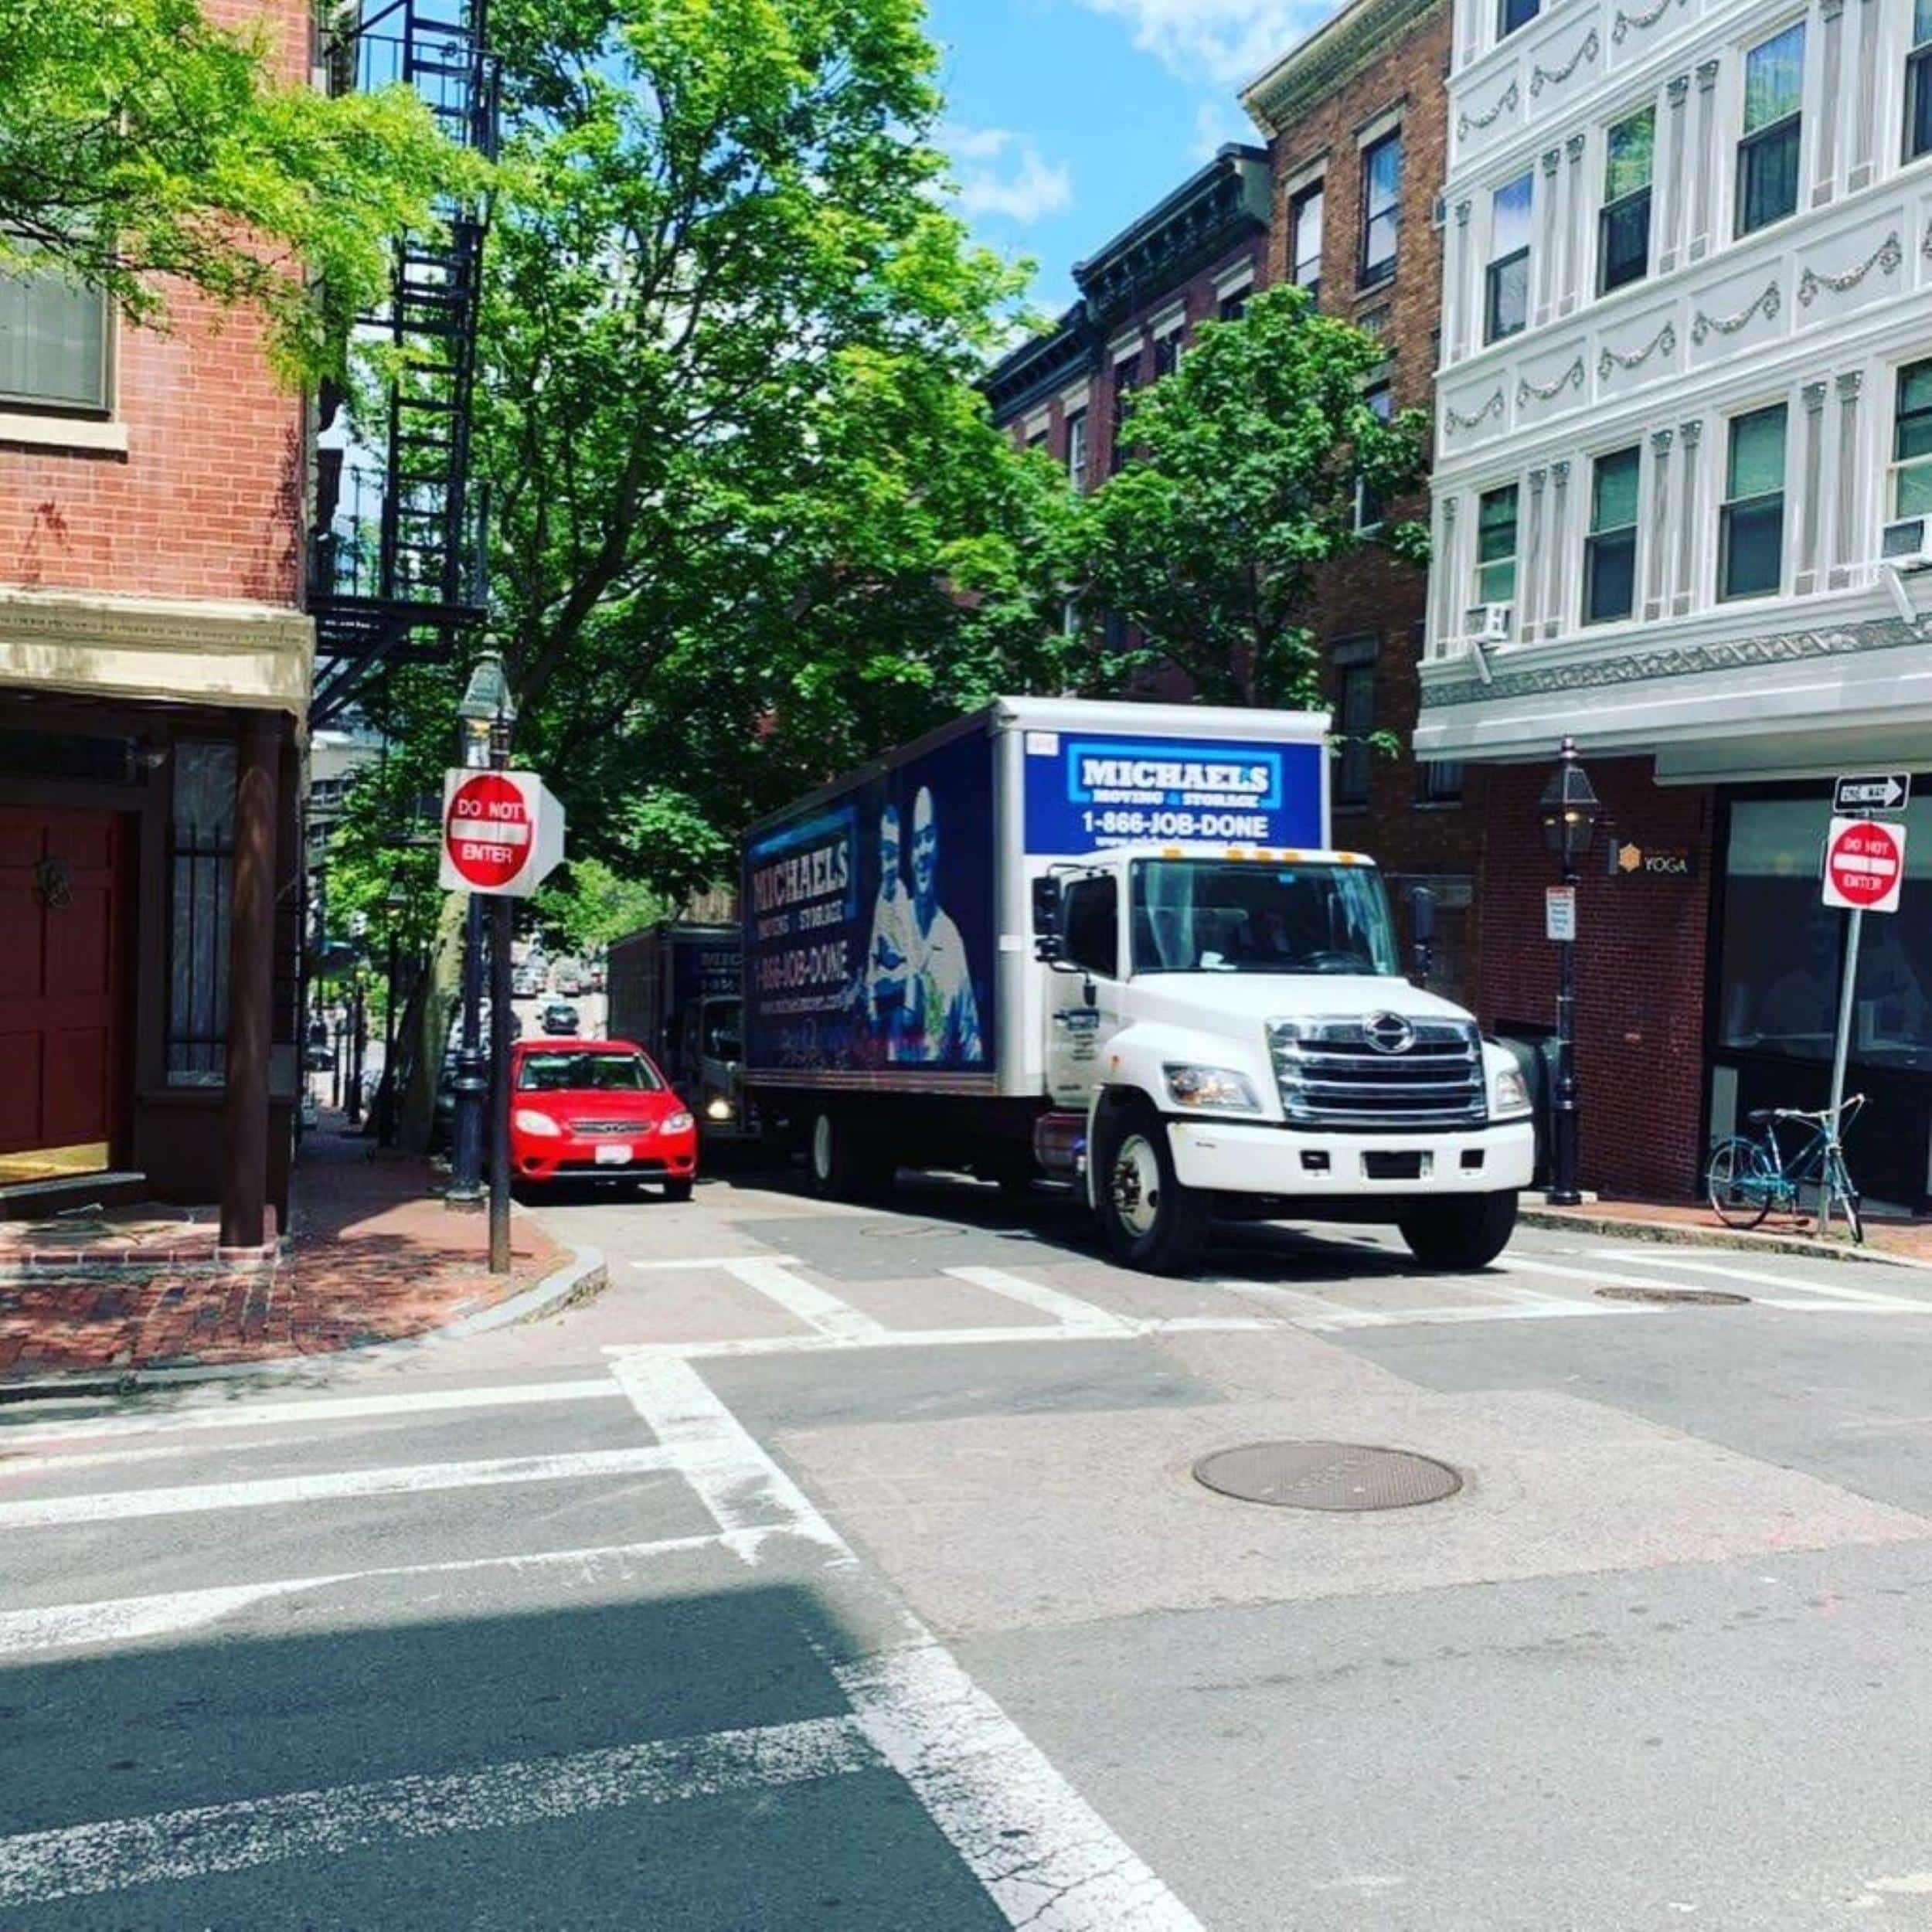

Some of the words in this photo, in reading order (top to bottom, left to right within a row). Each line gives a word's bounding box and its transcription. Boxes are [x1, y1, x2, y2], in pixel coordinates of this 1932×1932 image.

[457, 798, 481, 817] DO
[488, 801, 524, 819] NOT
[1083, 811, 1268, 838] 1-866-JOB-DONE
[461, 843, 512, 864] ENTER
[1844, 836, 1862, 851] DO
[1865, 840, 1889, 855] NOT
[1645, 857, 1688, 873] YOGA
